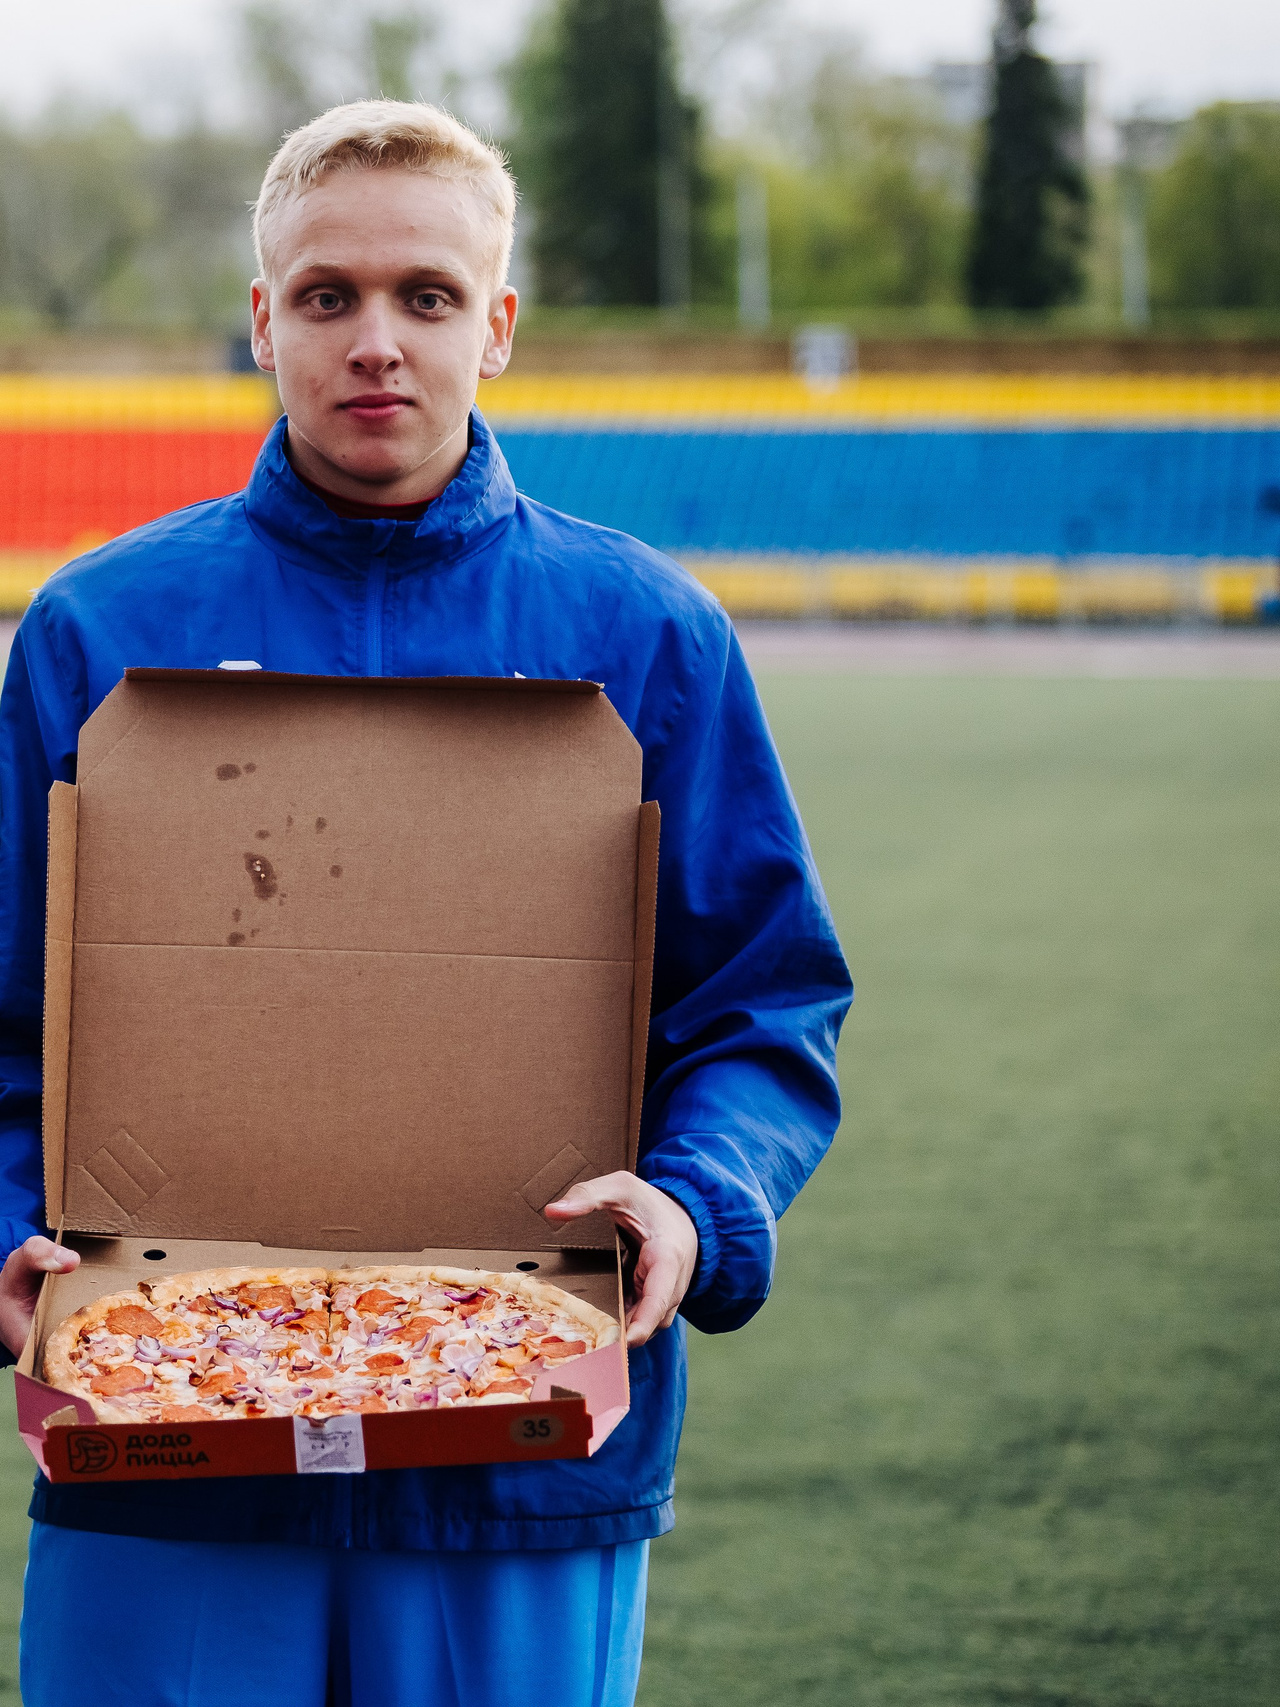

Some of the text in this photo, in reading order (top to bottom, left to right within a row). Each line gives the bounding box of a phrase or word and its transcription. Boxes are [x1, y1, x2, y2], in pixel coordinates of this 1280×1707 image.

[523, 1418, 551, 1439] 35
[125, 1433, 192, 1450] ДОДО
[125, 1450, 211, 1468] ПИЦЦА
